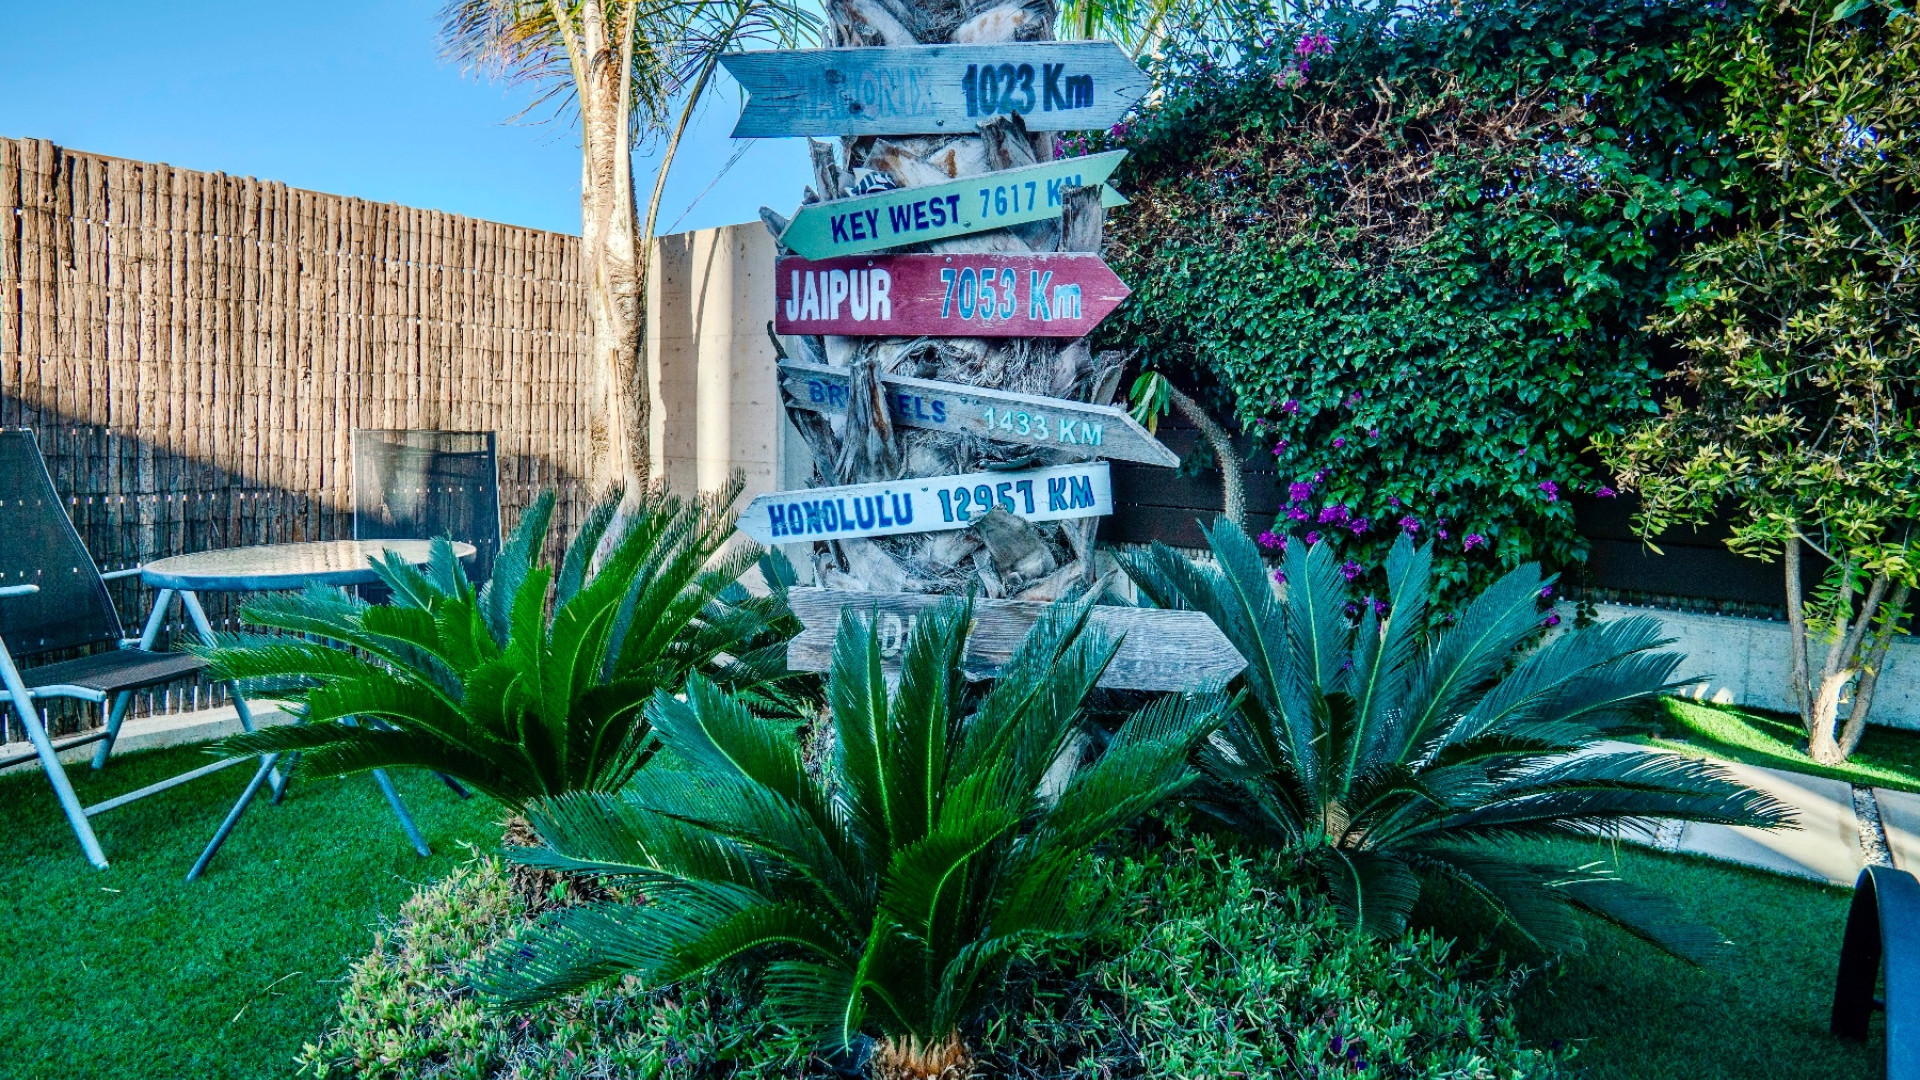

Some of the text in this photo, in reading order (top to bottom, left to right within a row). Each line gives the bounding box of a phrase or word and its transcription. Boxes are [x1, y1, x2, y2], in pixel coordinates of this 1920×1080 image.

[961, 63, 1035, 117] 1023
[1043, 63, 1093, 112] Km
[830, 207, 881, 244] KEY
[888, 194, 960, 233] WEST
[979, 181, 1036, 218] 7617
[786, 267, 1082, 321] JAIPUR 7053 Km
[809, 381, 1103, 446] BRELS 1433 KM
[768, 476, 1095, 537] HONOLULU 12957 KM
